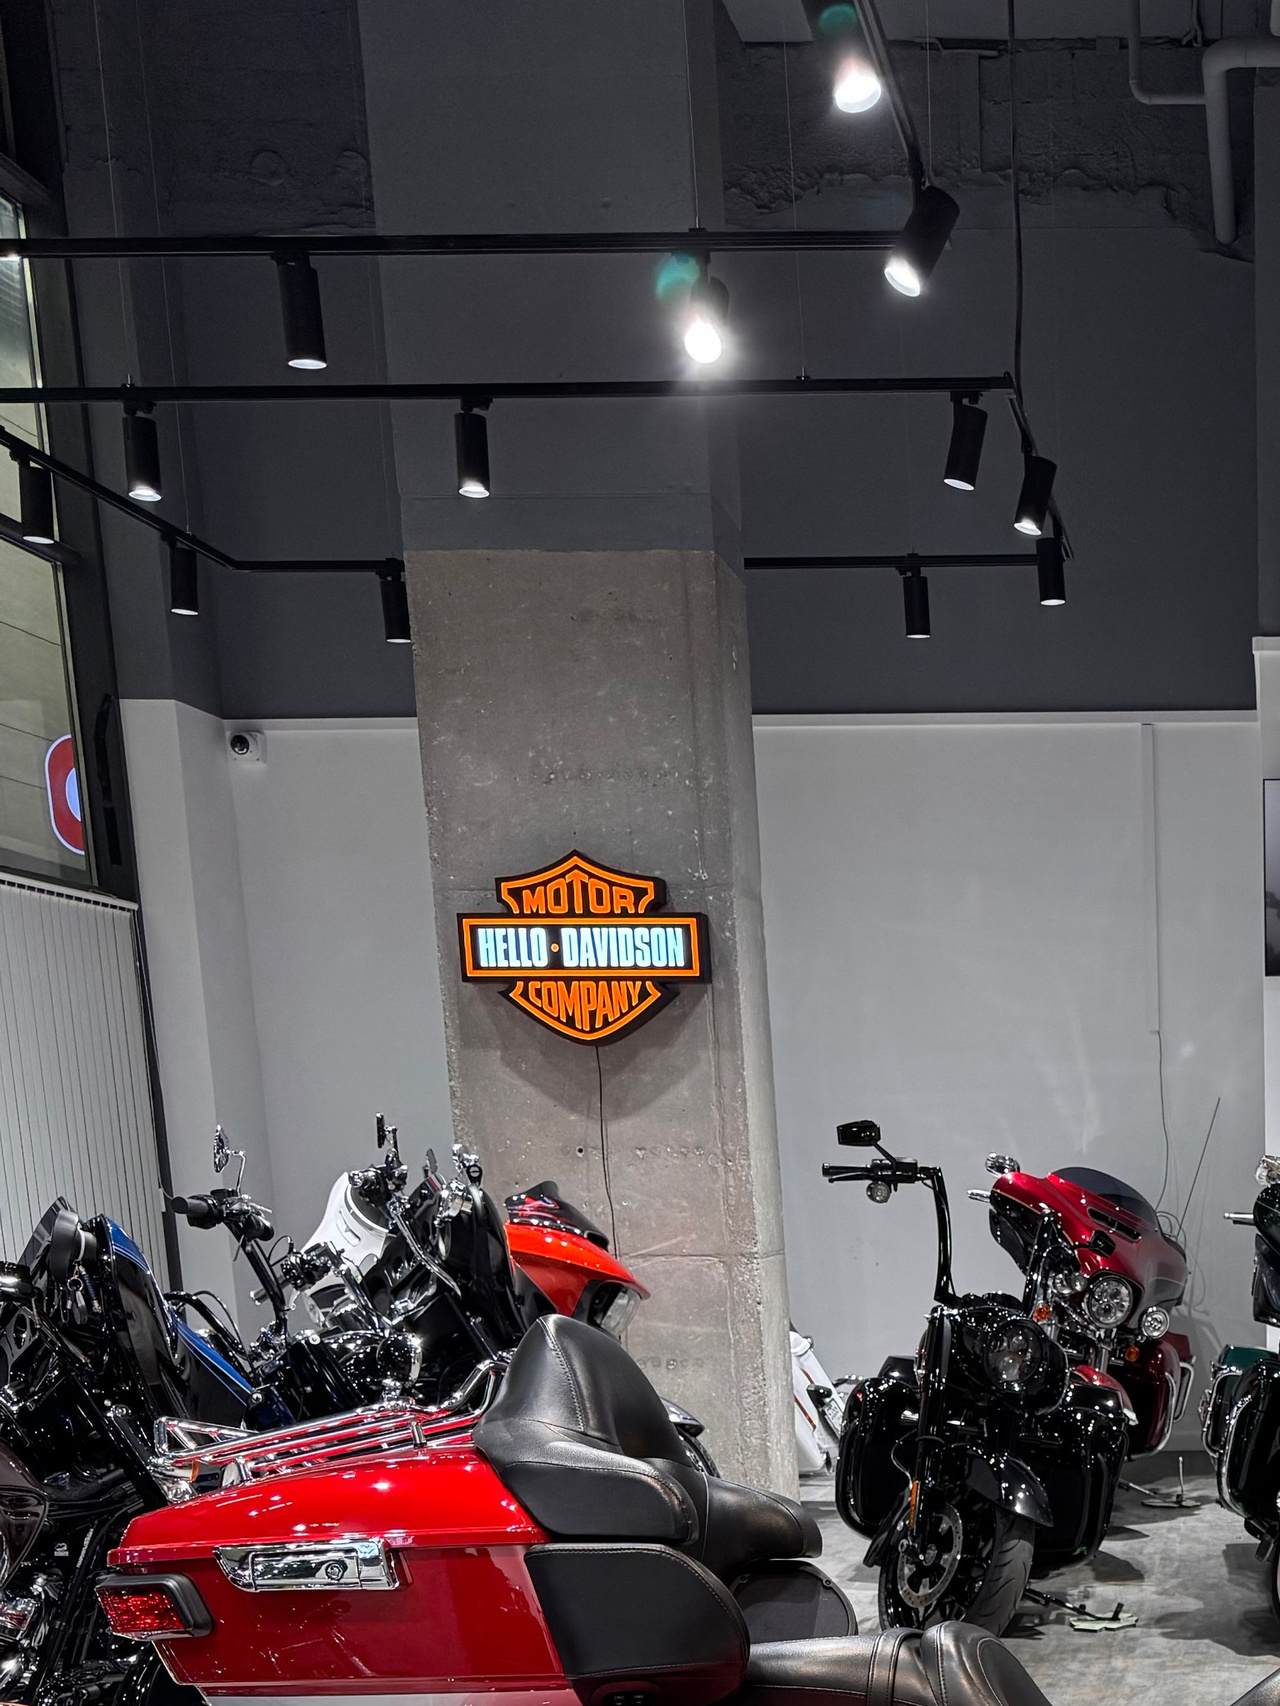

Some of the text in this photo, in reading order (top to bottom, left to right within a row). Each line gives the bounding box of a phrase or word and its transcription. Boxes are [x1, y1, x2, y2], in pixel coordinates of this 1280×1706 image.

[522, 869, 635, 914] MOTOR
[477, 927, 685, 968] HELLO DAVIDSON
[528, 980, 642, 1031] COMPANY
